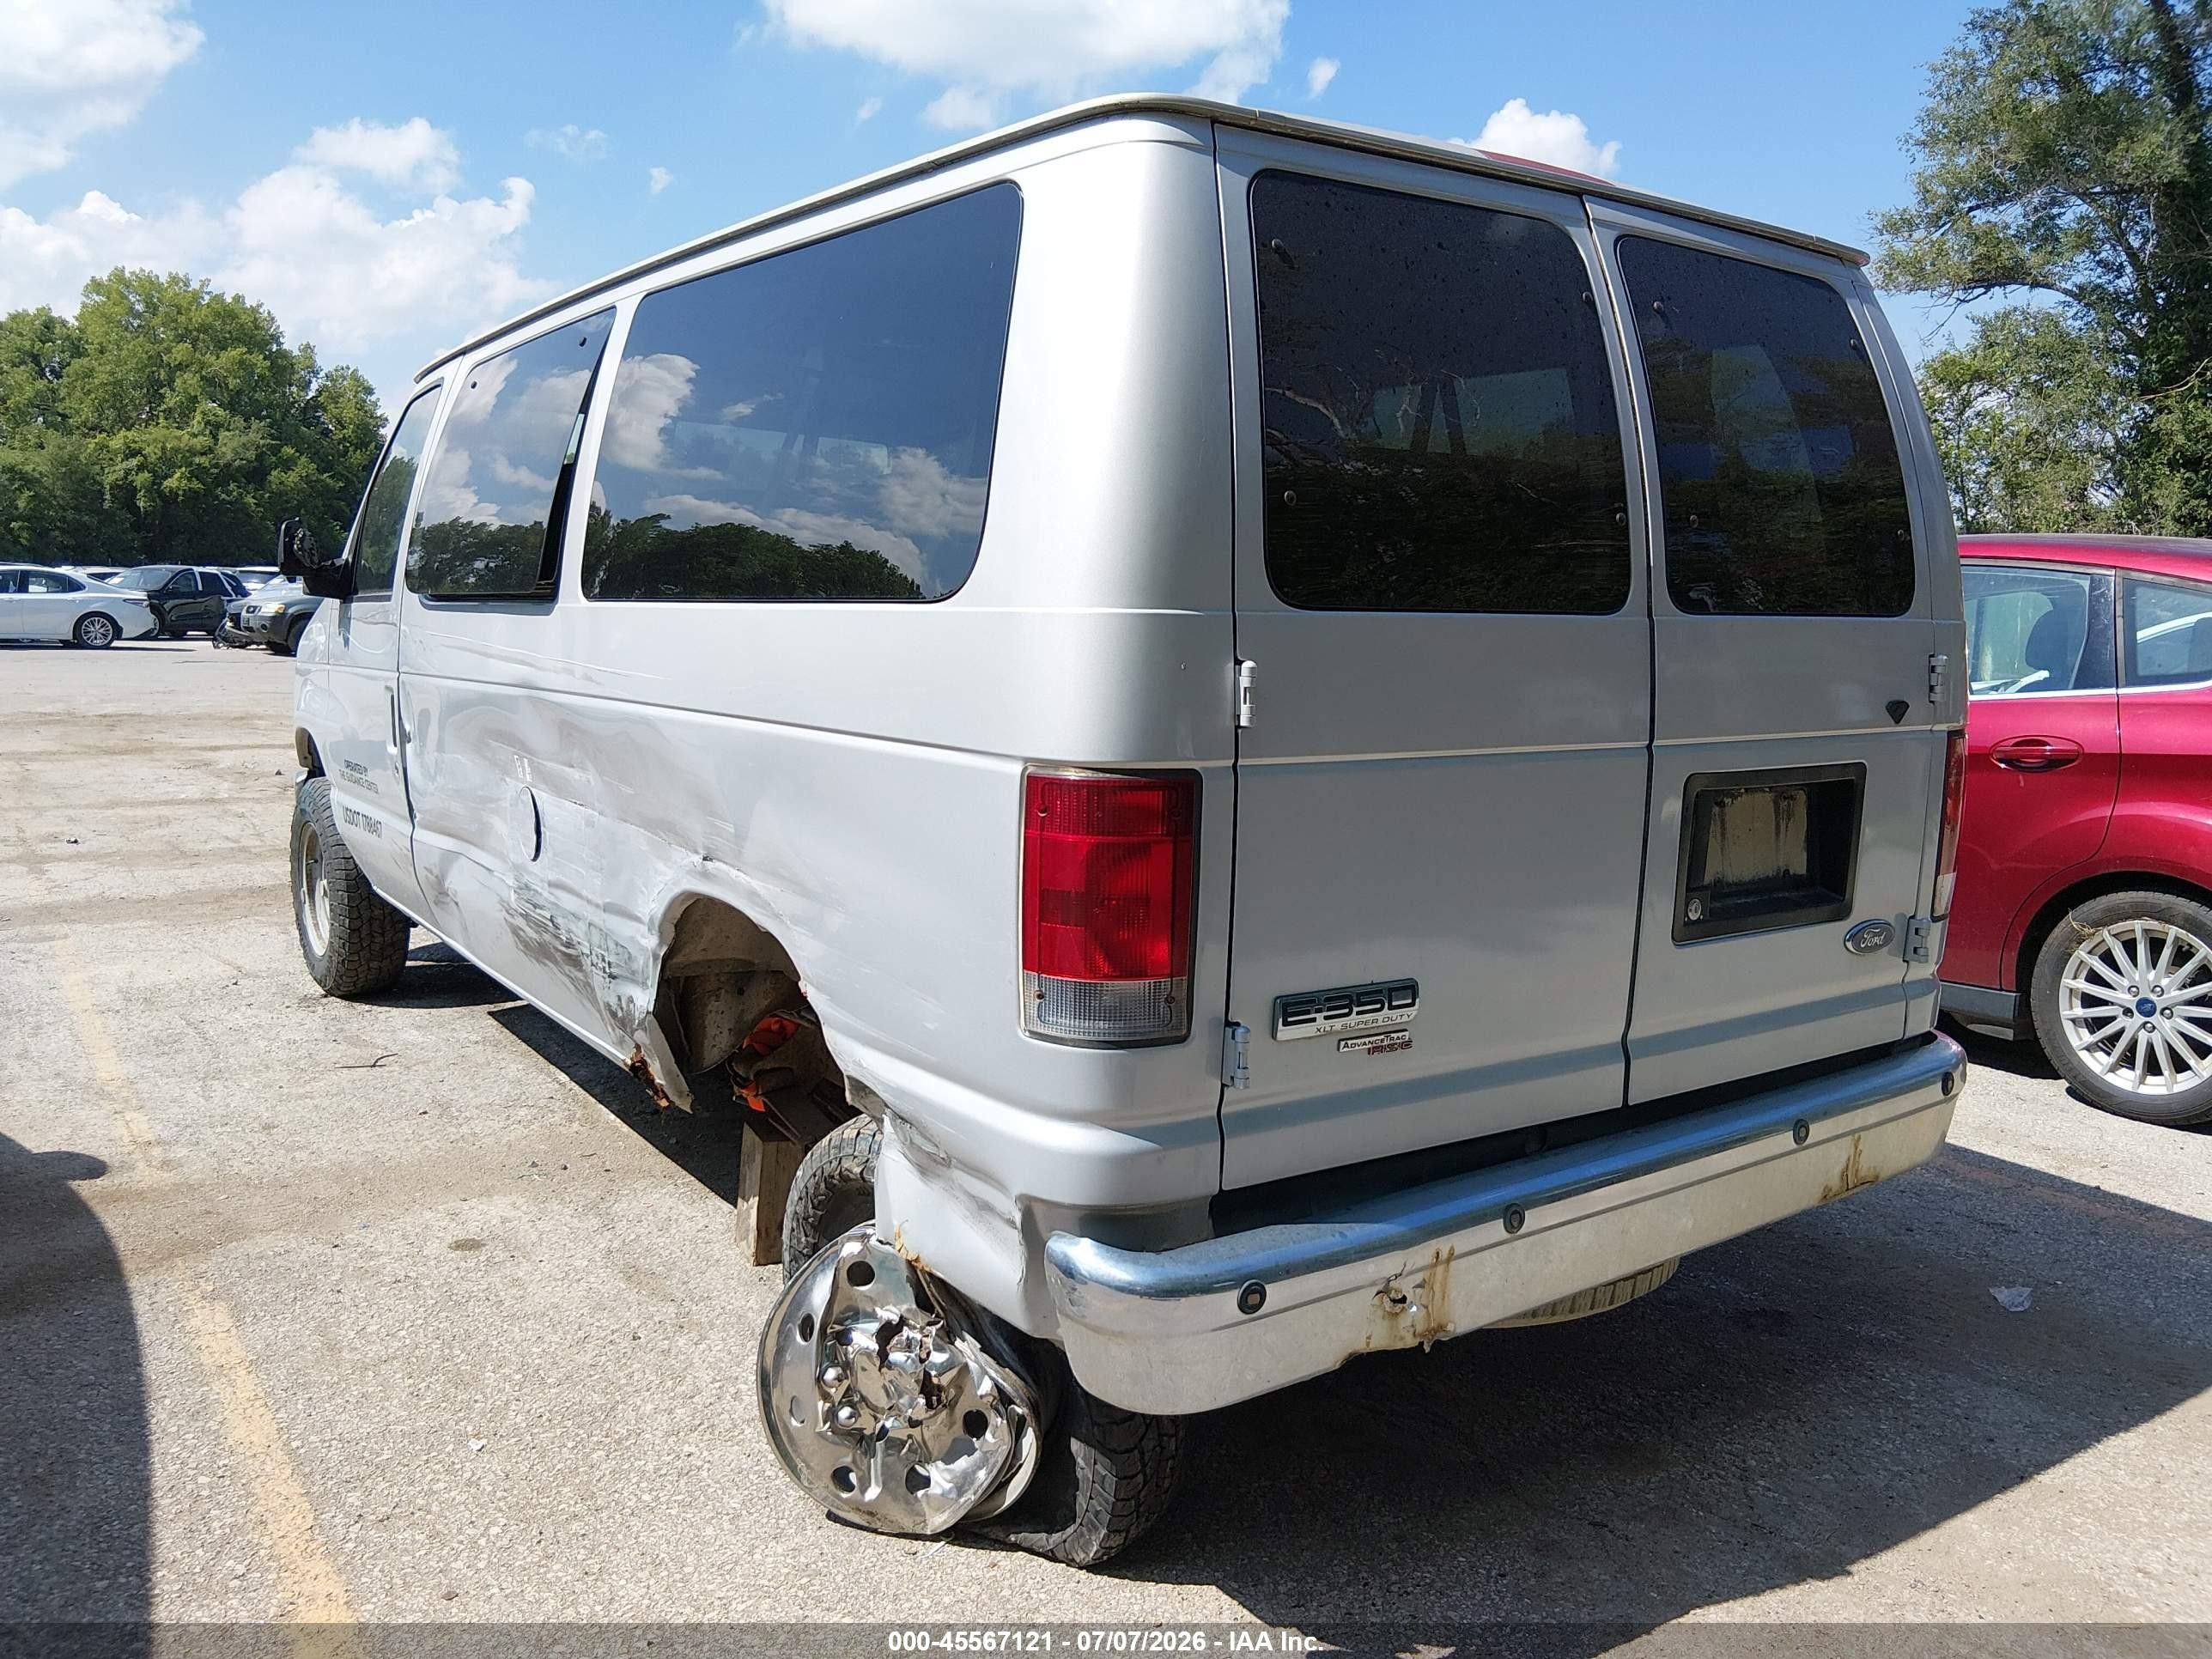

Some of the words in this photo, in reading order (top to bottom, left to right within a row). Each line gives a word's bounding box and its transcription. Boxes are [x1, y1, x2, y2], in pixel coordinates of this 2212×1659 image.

[343, 805, 361, 830] USDOT
[1861, 928, 1886, 948] Ford
[1314, 1024, 1335, 1034] XLT
[1340, 1018, 1378, 1030] SUPER
[1382, 1012, 1413, 1024] DUTY
